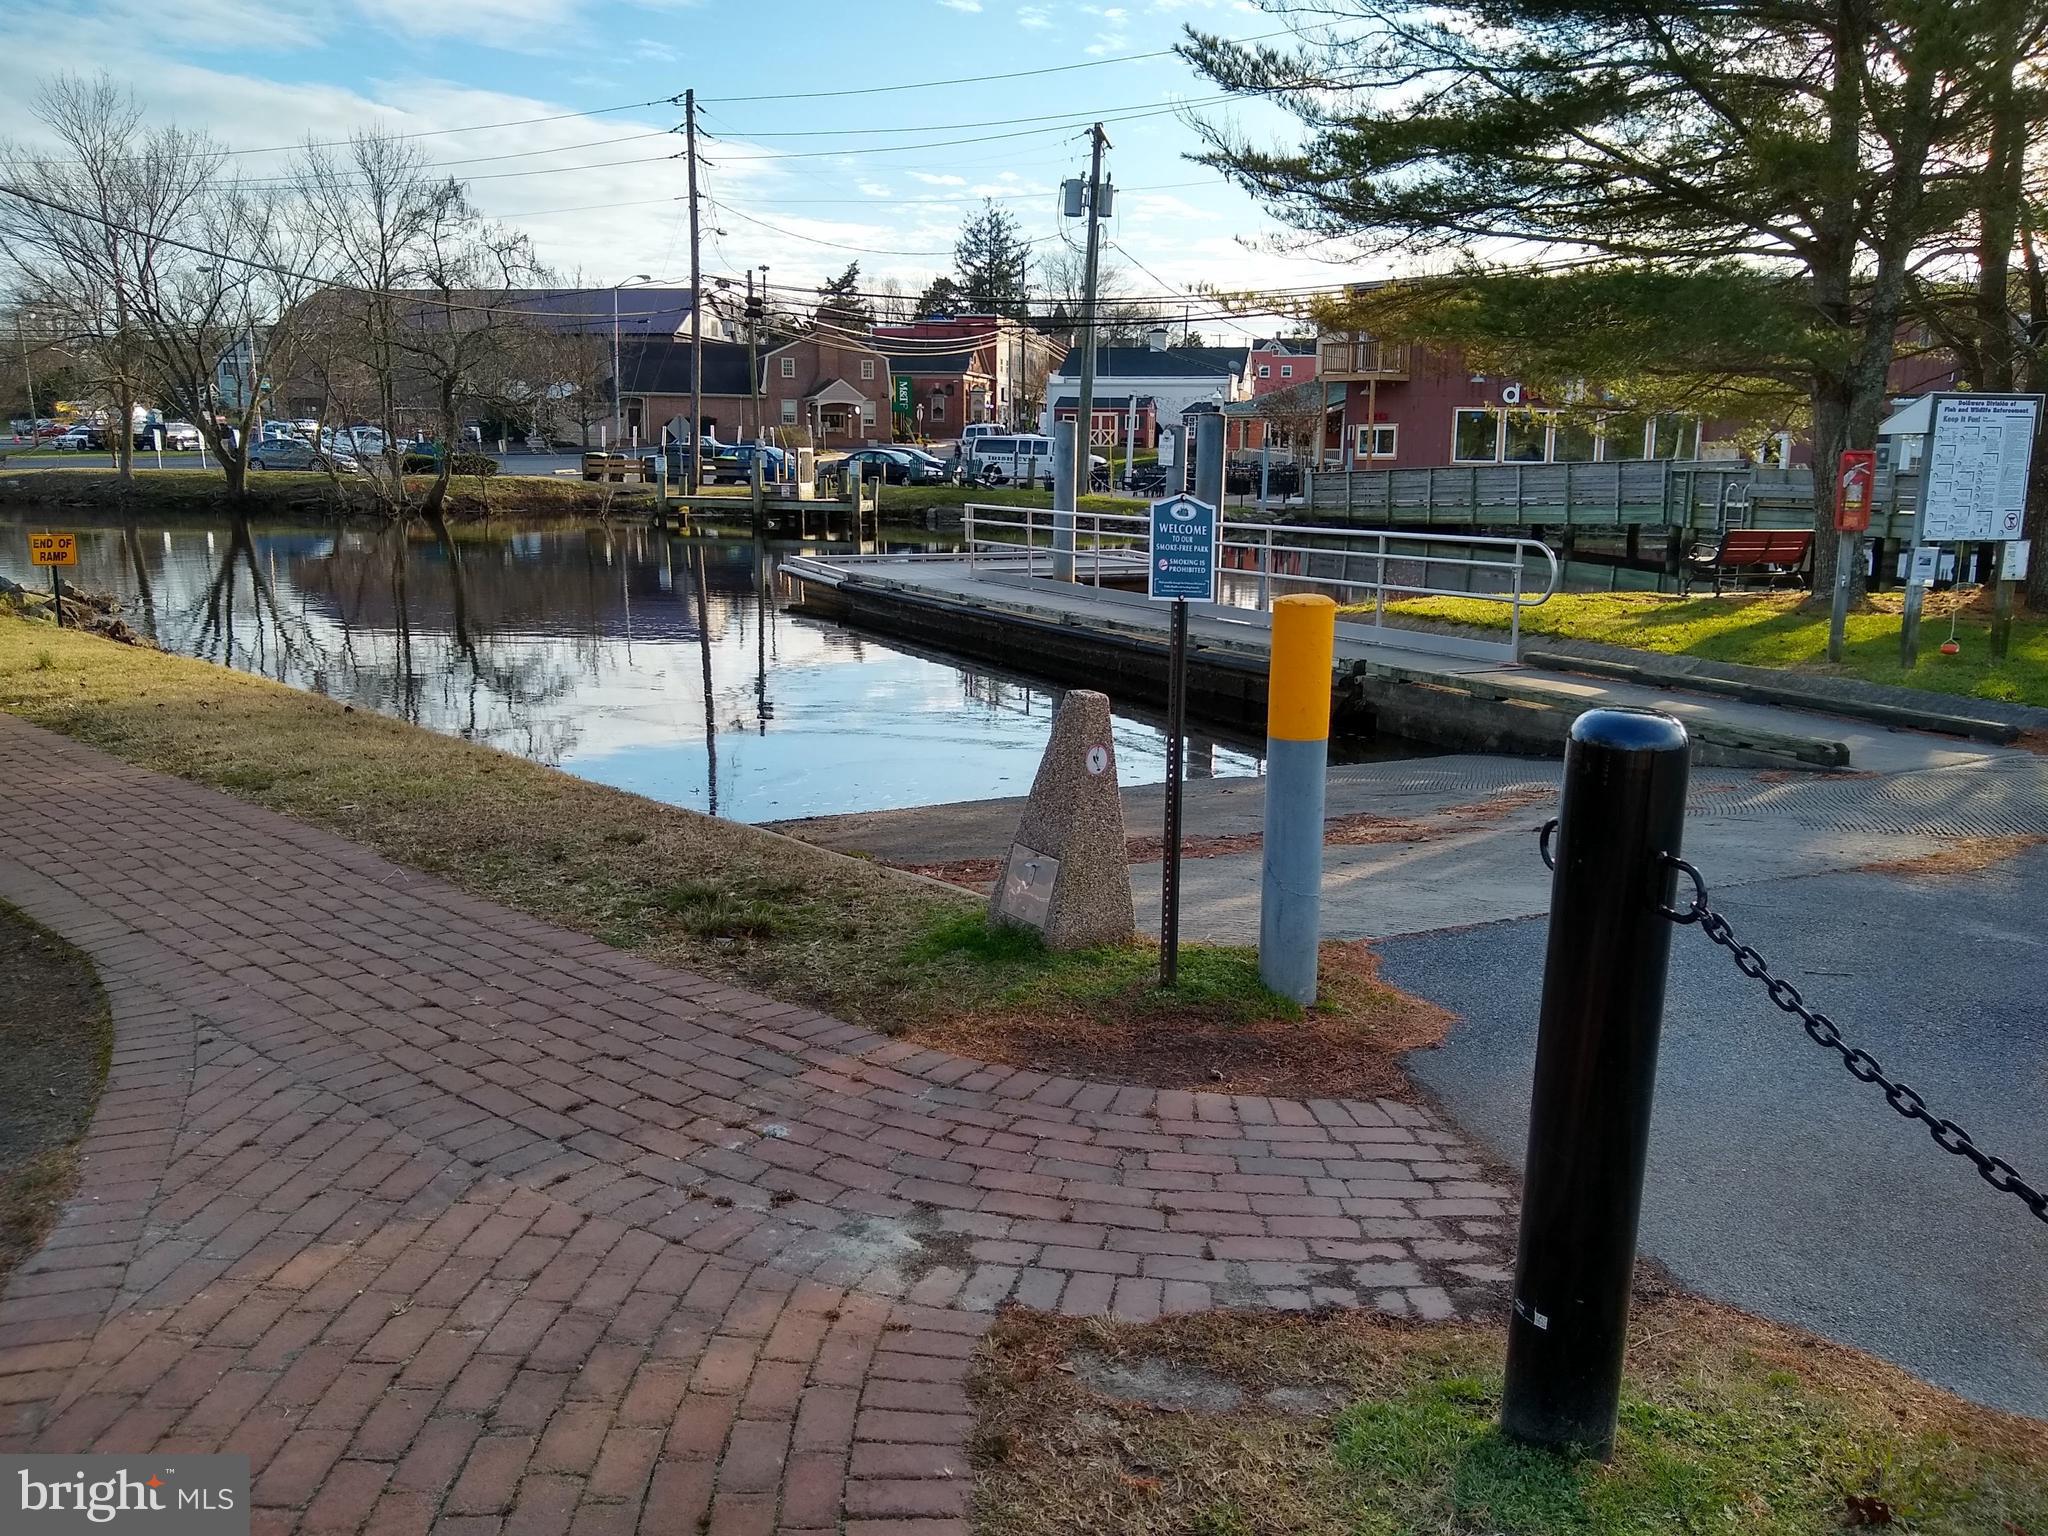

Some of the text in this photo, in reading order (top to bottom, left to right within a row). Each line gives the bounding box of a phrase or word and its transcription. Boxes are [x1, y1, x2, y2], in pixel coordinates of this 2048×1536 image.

[1159, 523, 1207, 535] WELCOME
[33, 539, 72, 548] END OF
[1156, 544, 1209, 553] SMOKE-FREE PARK
[40, 552, 68, 561] RAMP
[1168, 566, 1206, 574] PROHIBITED
